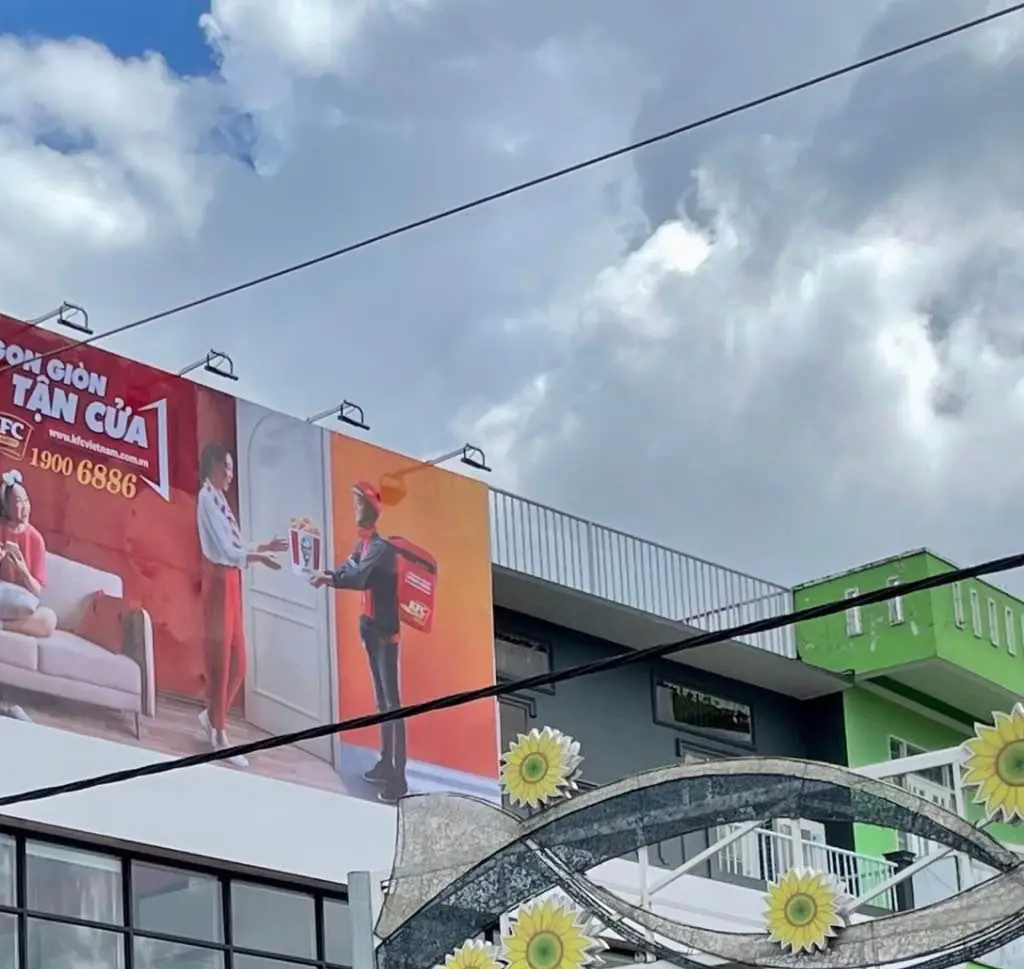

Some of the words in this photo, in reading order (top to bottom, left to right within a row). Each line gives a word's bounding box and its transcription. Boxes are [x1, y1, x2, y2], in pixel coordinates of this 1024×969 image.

[46, 362, 107, 397] GIÒN
[12, 373, 78, 423] TẬN
[85, 397, 148, 448] CỬA
[29, 448, 73, 476] 1900
[77, 459, 137, 499] 6886
